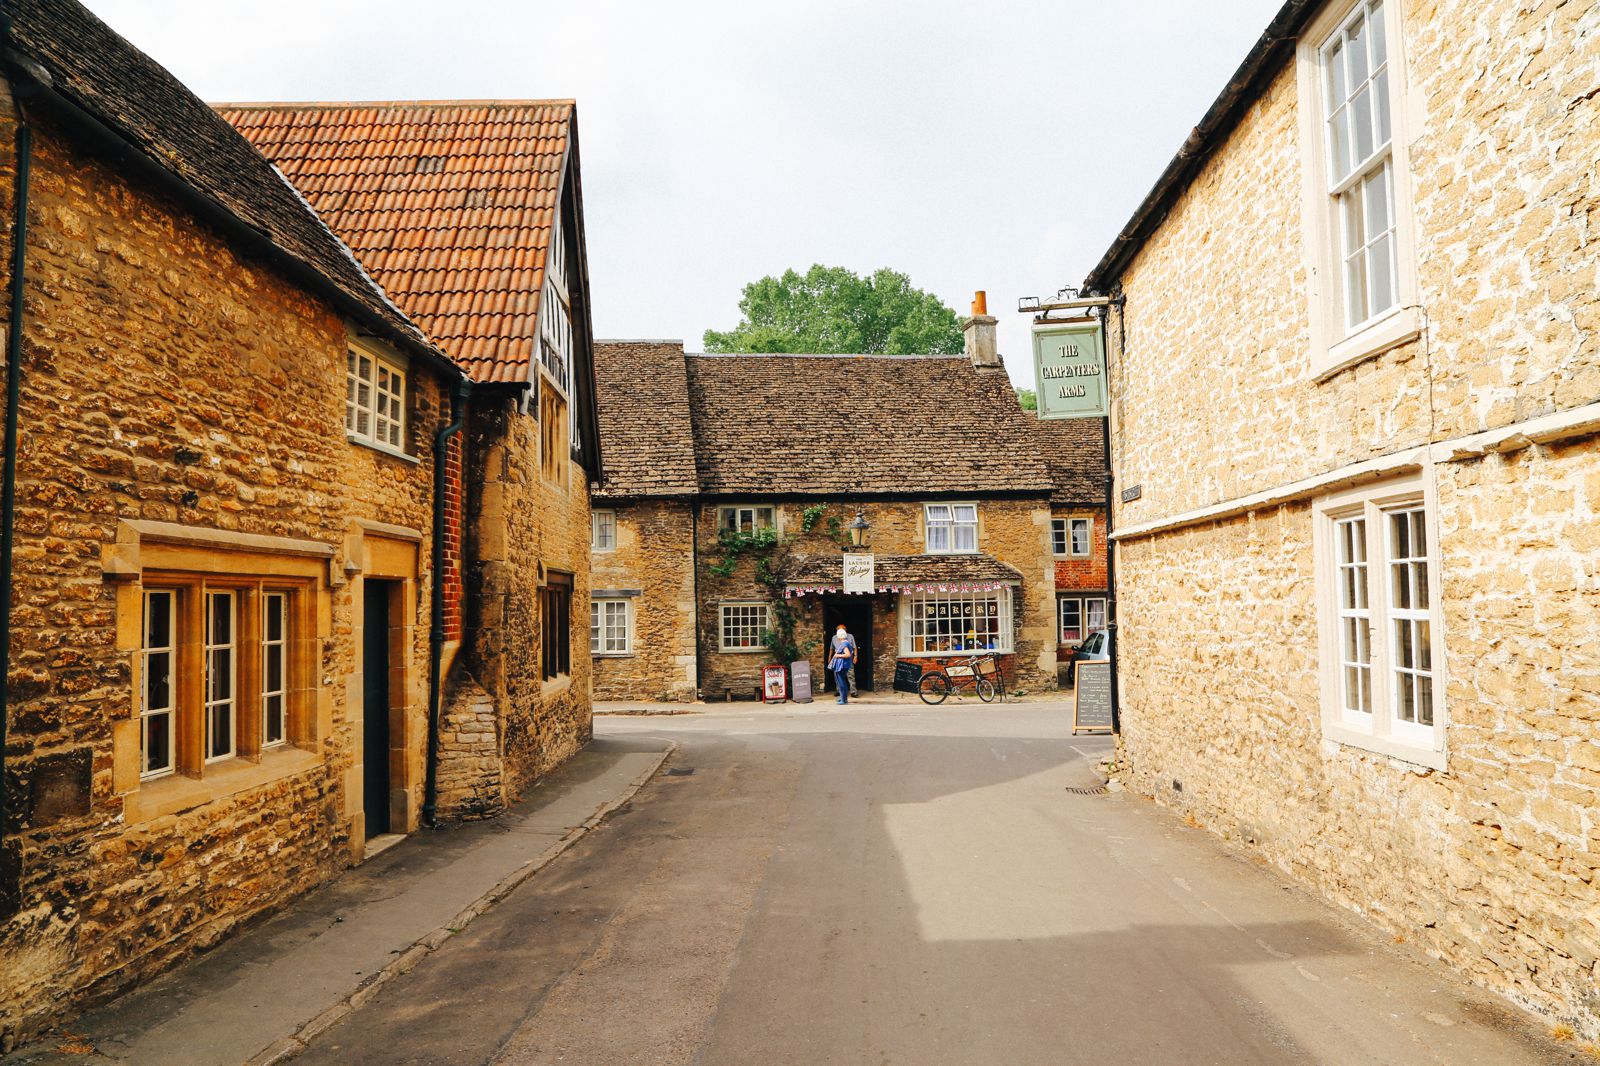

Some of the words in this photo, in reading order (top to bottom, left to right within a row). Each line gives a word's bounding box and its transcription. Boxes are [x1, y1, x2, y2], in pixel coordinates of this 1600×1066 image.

[1059, 345, 1078, 358] THE
[1042, 363, 1100, 379] CARPENTERS
[1059, 385, 1085, 398] ARMS
[926, 605, 996, 615] BAKERY
